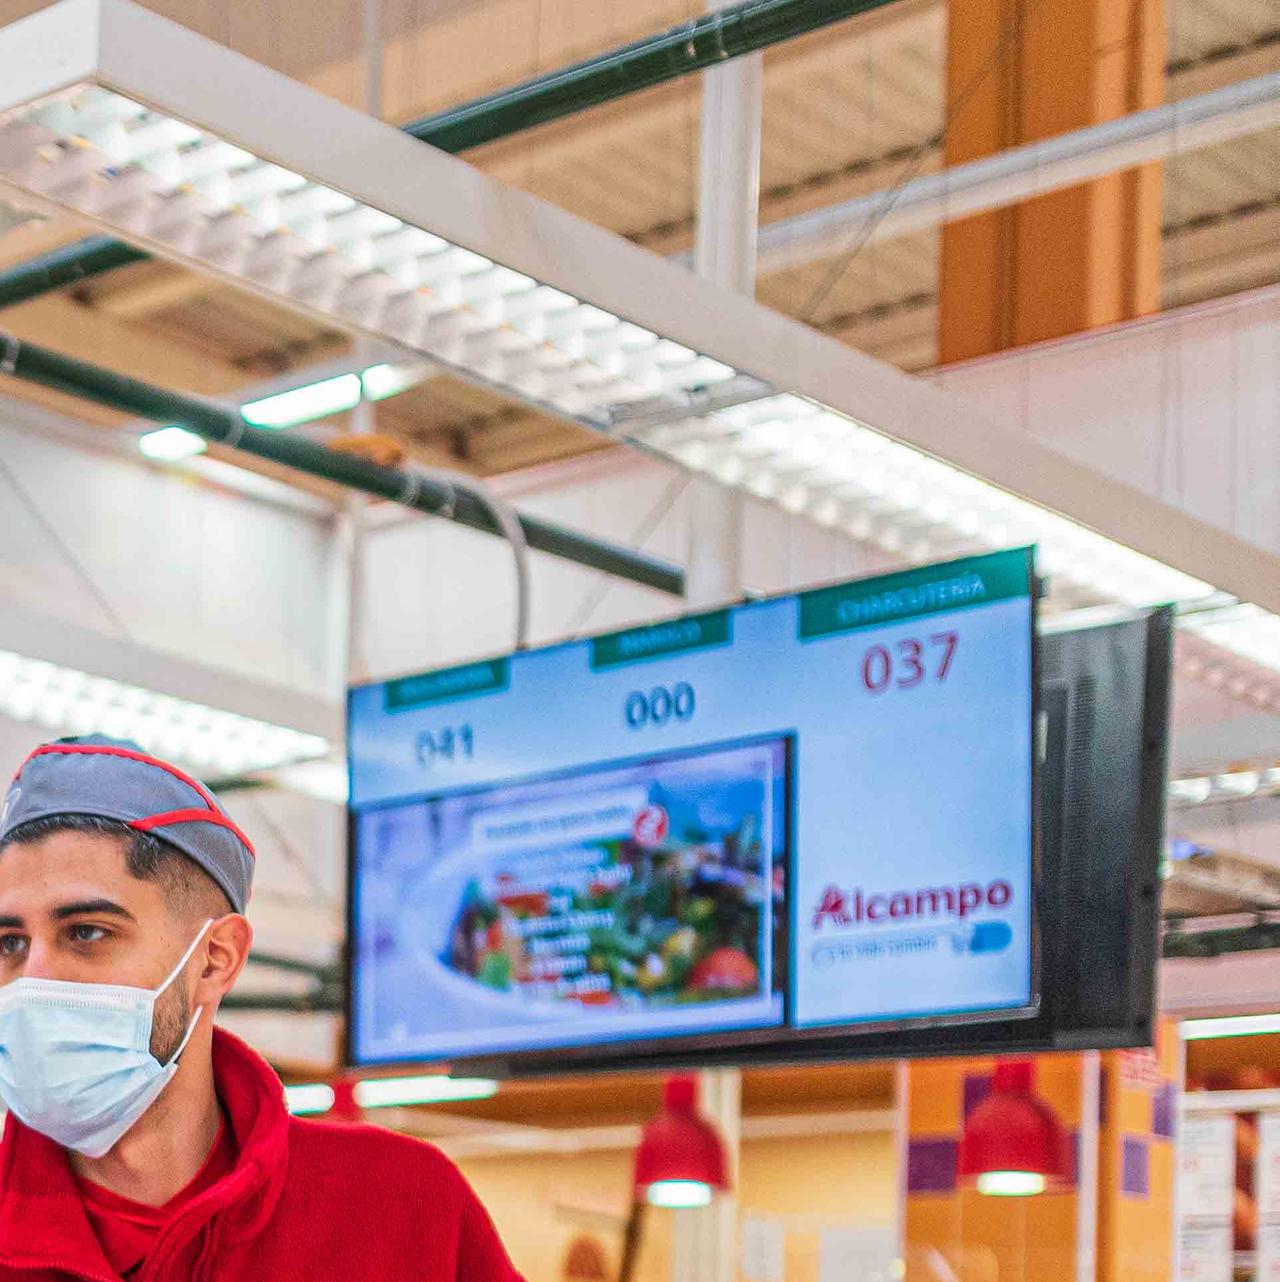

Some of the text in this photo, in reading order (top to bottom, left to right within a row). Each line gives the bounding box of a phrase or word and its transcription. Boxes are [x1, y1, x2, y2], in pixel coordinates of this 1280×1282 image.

[862, 630, 959, 693] 037
[623, 680, 696, 730] 000
[416, 726, 473, 767] 041
[811, 880, 1013, 930] Alcampo
